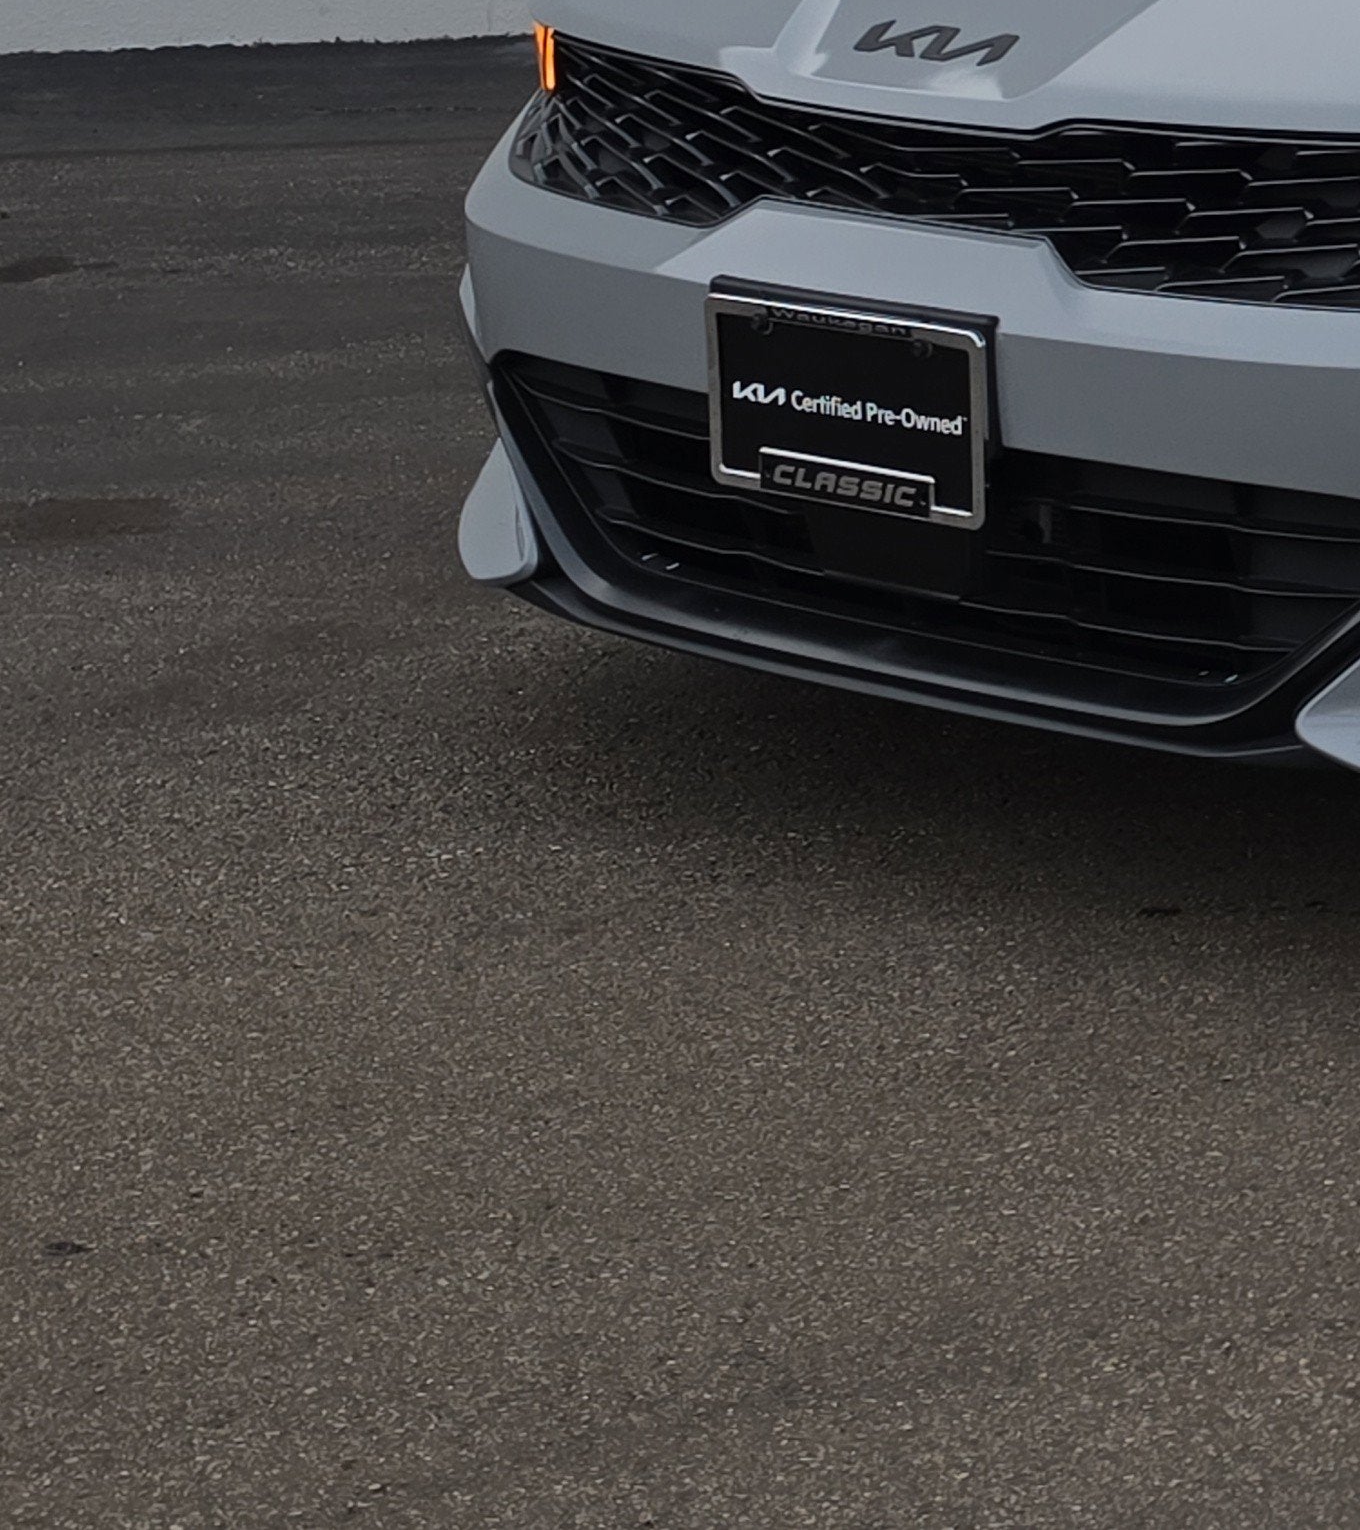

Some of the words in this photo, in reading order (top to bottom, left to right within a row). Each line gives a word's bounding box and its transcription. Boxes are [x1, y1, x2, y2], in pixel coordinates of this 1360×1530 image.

[853, 19, 1020, 67] KIA
[773, 307, 908, 337] Waukegan
[732, 380, 786, 406] KIA
[791, 391, 862, 421] Certified
[866, 402, 963, 435] Pre-Owned
[772, 464, 918, 508] CLASSIC
